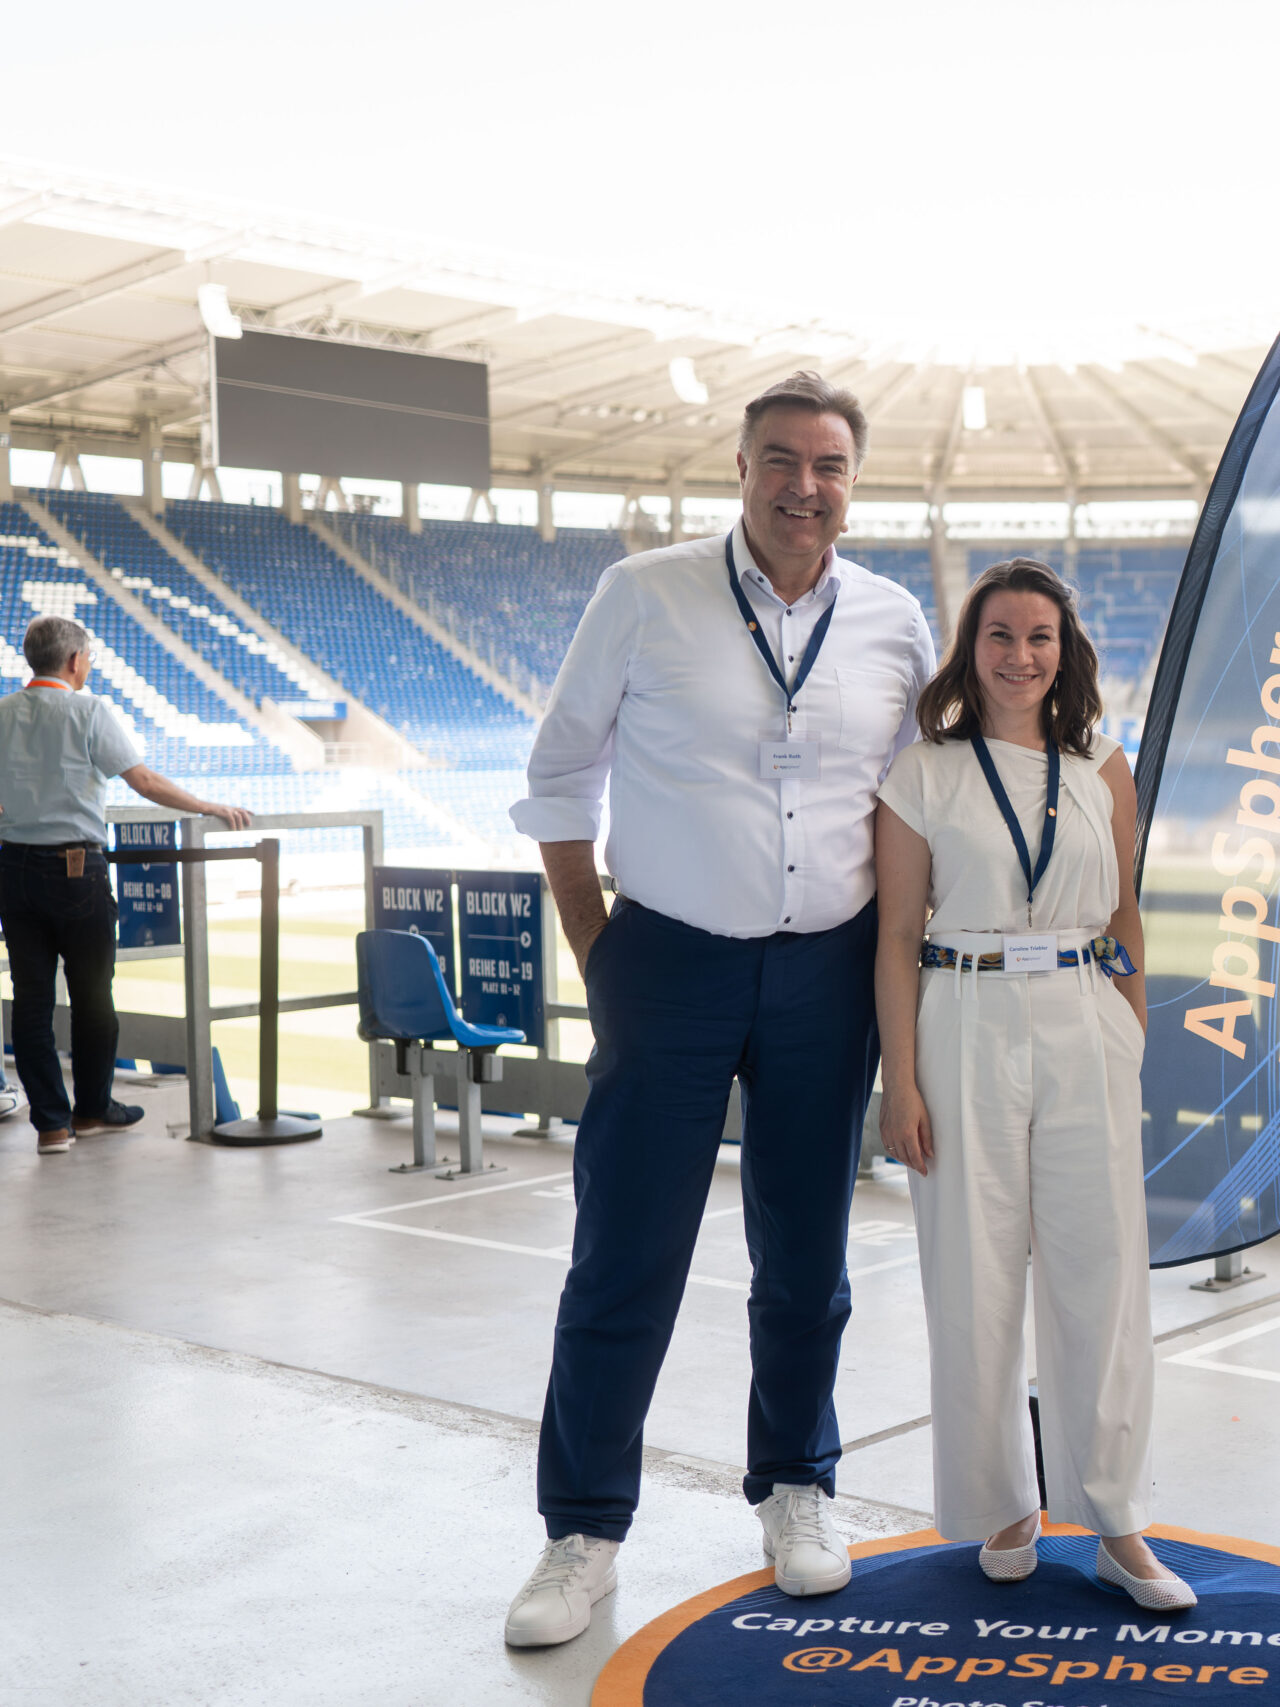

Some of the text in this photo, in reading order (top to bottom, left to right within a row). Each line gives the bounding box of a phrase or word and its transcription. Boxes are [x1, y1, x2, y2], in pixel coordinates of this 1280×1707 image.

[120, 823, 169, 846] BLOCK W2
[123, 881, 144, 898] REIHE
[382, 887, 444, 912] BLOCK W2
[466, 891, 531, 917] BLOCK W2
[468, 958, 496, 978] REIHE
[731, 1612, 950, 1637] Capture
[973, 1618, 1098, 1640] Your
[782, 1646, 1269, 1685] @AppSphere
